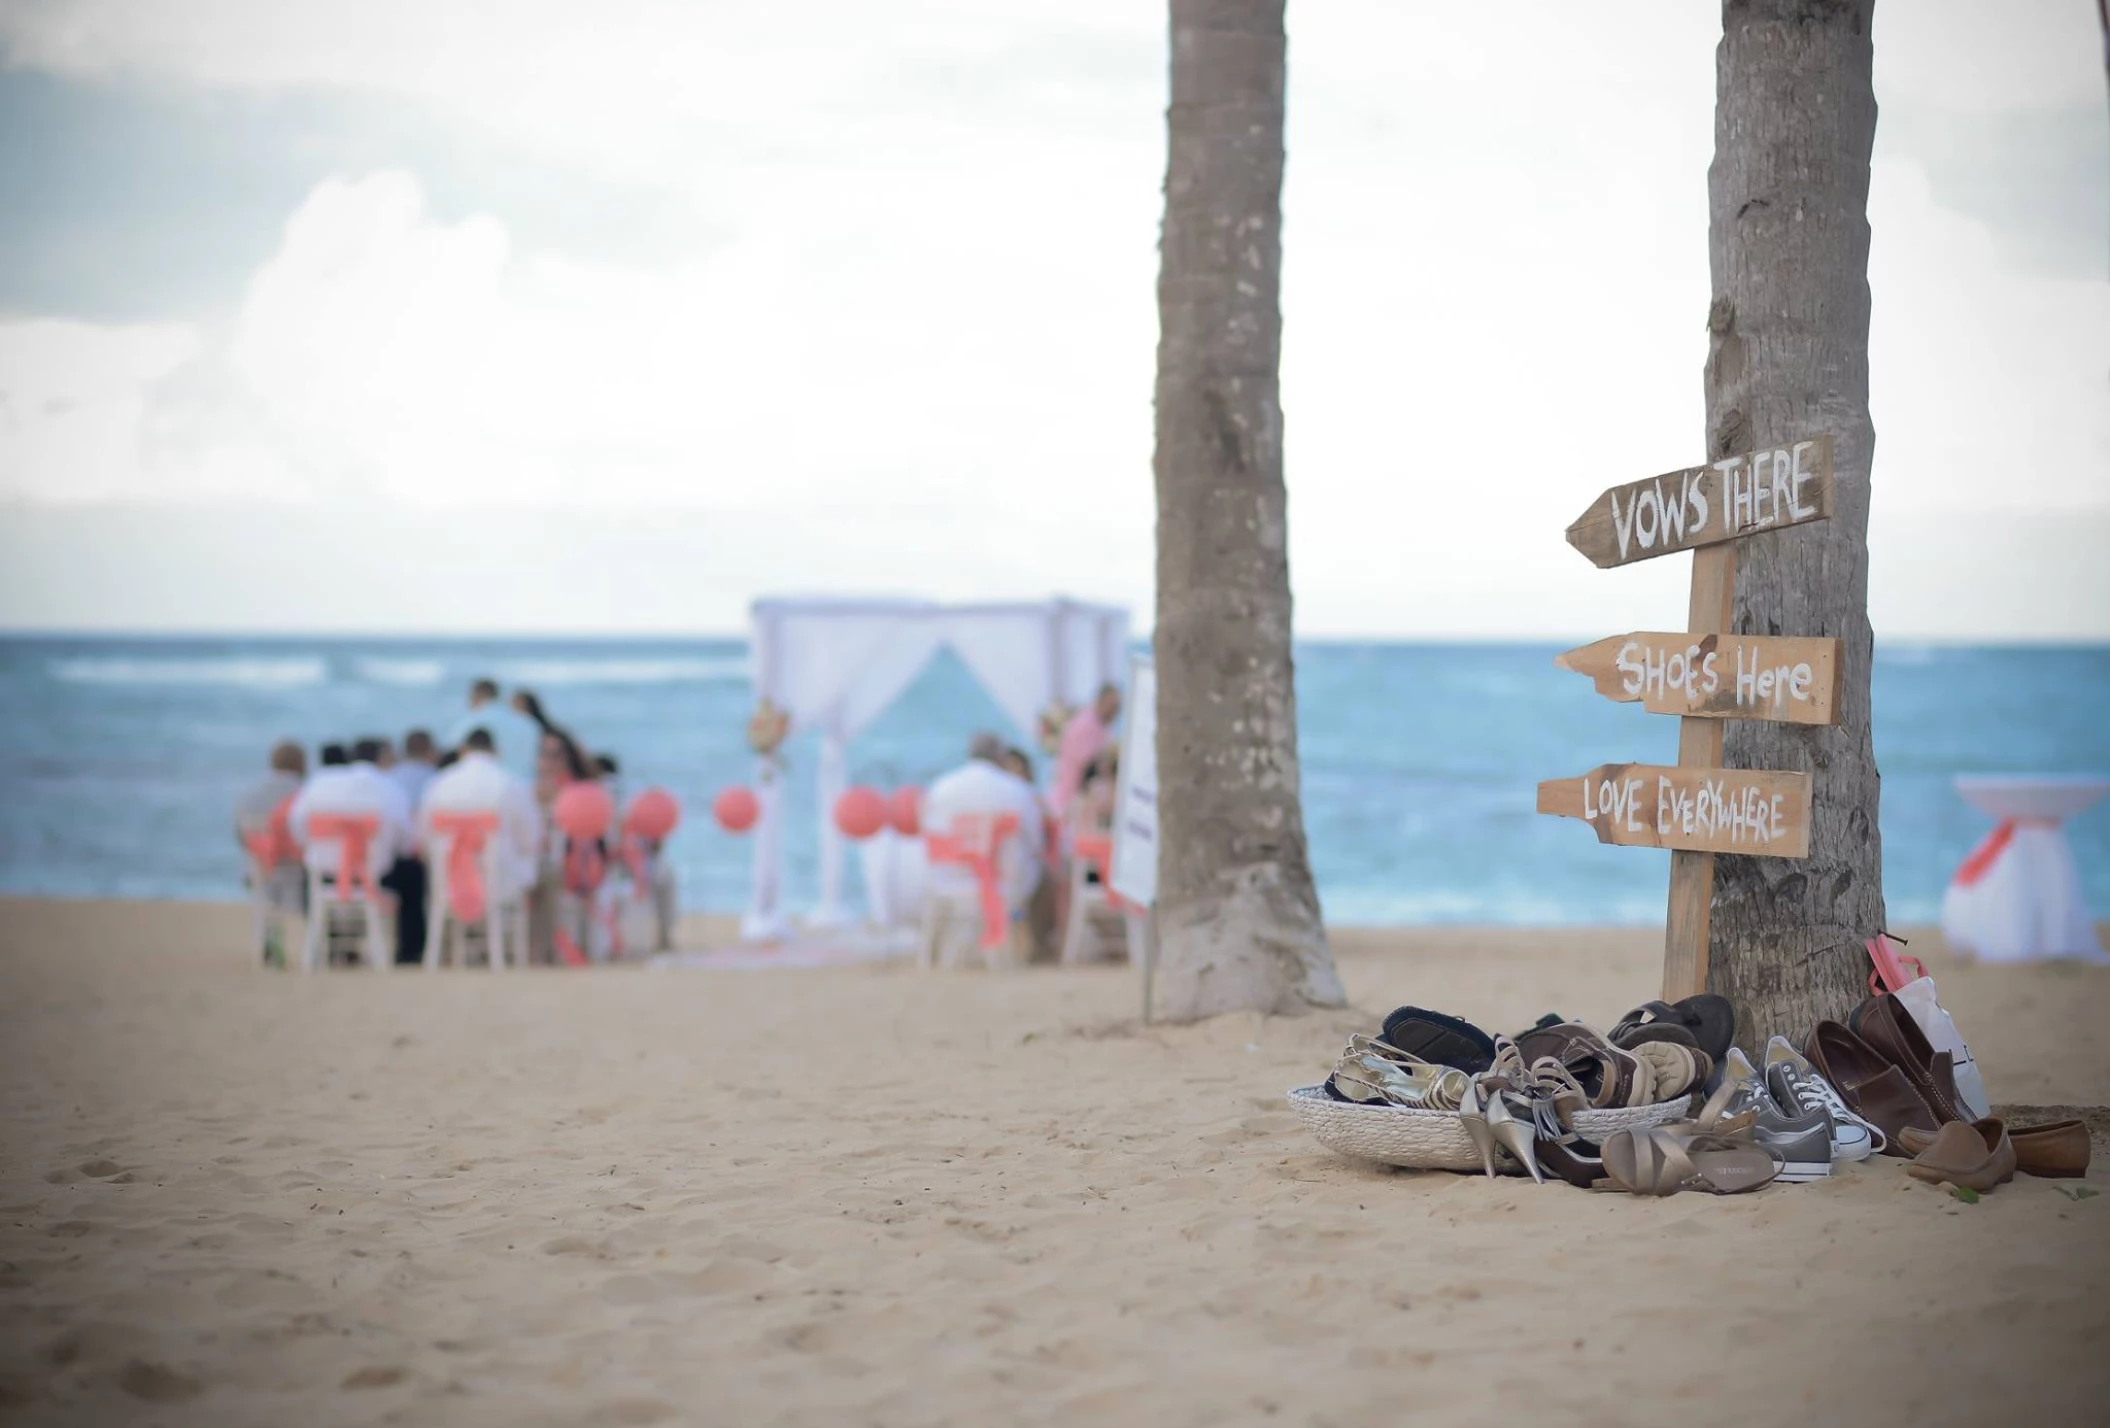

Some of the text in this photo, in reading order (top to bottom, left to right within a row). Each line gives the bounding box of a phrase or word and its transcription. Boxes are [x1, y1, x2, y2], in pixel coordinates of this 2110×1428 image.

[1611, 442, 1817, 559] VOWS THERE
[1616, 642, 1813, 706] SHOES Here
[1583, 775, 1785, 842] LOVE EVERYWHERE
